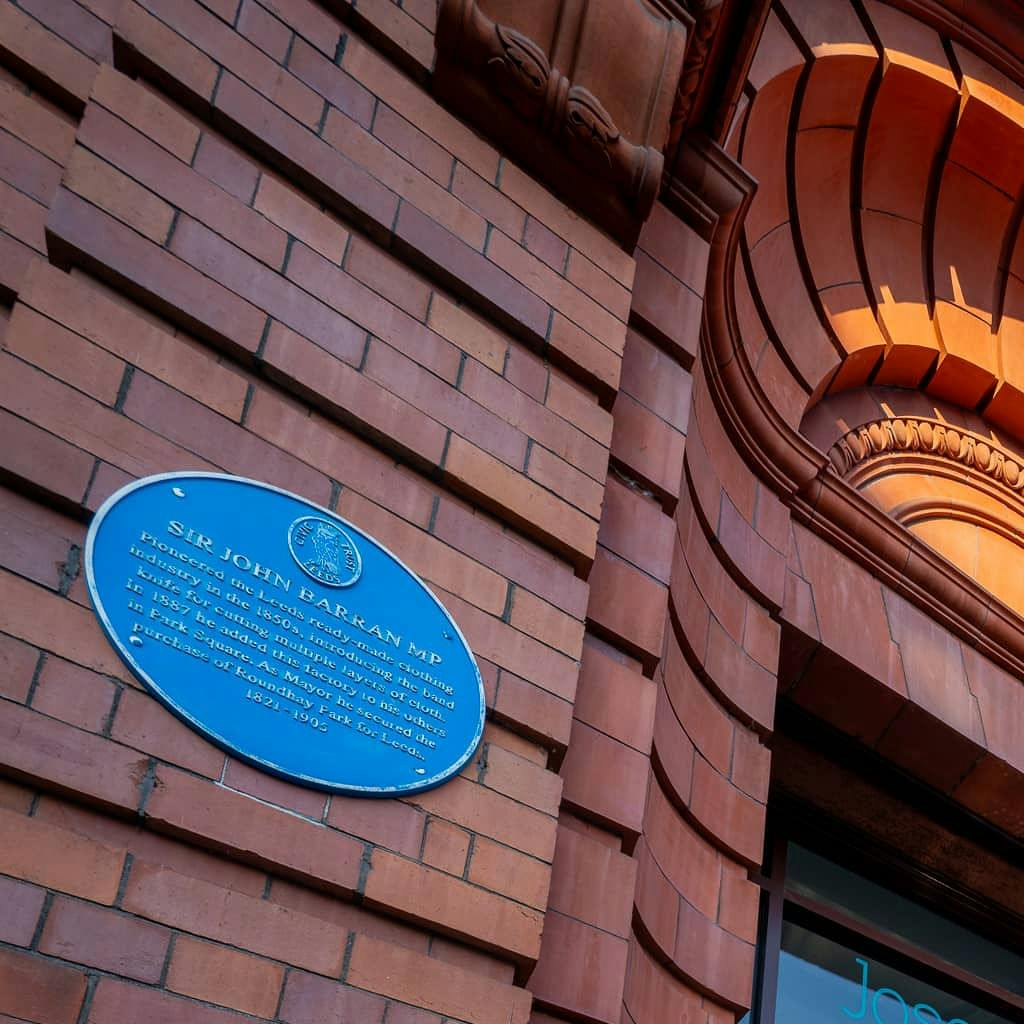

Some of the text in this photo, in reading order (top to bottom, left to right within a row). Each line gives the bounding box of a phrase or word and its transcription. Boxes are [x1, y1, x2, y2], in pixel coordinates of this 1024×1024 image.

[167, 520, 443, 666] SIR JOHN BARRAN MP
[295, 521, 314, 545] CIVIC
[304, 559, 341, 583] LEEDS
[341, 543, 356, 573] TRUST
[127, 598, 436, 749] in Park Square. As Mayor he secured the
[129, 544, 201, 586] industry
[205, 581, 222, 598] in
[226, 592, 250, 611] the
[309, 632, 393, 683] introducing
[398, 676, 419, 694] the
[423, 687, 455, 711] band
[136, 565, 180, 595] knife
[185, 589, 213, 608] for
[214, 606, 269, 640] cutting
[274, 634, 337, 671] multiple
[341, 664, 386, 694] layers
[390, 690, 408, 702] of
[140, 530, 454, 696] Pioneered the Leeds ready-made clothing
[152, 591, 191, 616] 1887
[195, 610, 217, 630] he
[219, 625, 268, 654] added
[272, 649, 301, 670] this
[303, 664, 358, 696] factory
[362, 691, 376, 704] to
[380, 700, 400, 716] his
[403, 713, 447, 738] others
[131, 622, 426, 762] purchase of Roundhay Park for Leeds.
